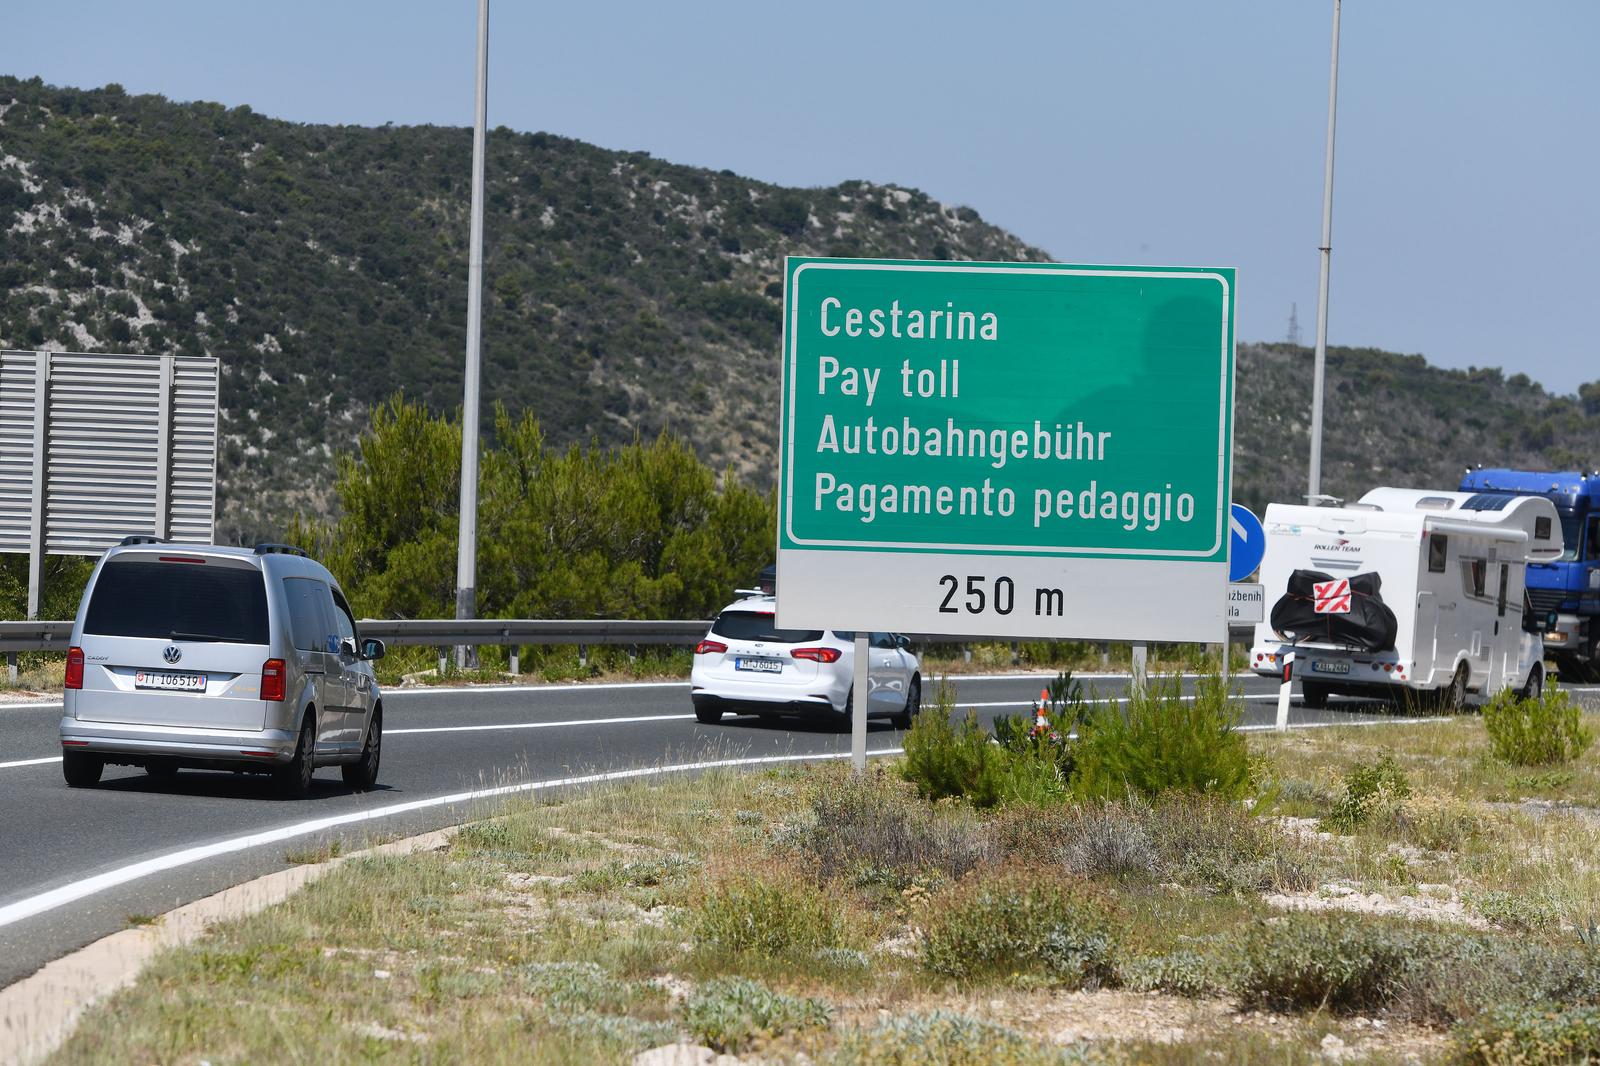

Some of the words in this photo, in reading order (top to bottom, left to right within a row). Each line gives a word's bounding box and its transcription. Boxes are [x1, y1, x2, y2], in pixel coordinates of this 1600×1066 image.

[820, 297, 998, 341] Cestarina
[818, 356, 881, 406] Pay
[900, 359, 960, 398] toll
[816, 414, 1112, 469] Autobahngebühr
[815, 472, 1016, 523] Pagamento
[1034, 480, 1195, 532] pedaggio
[938, 574, 1015, 615] 250
[1035, 588, 1064, 616] m
